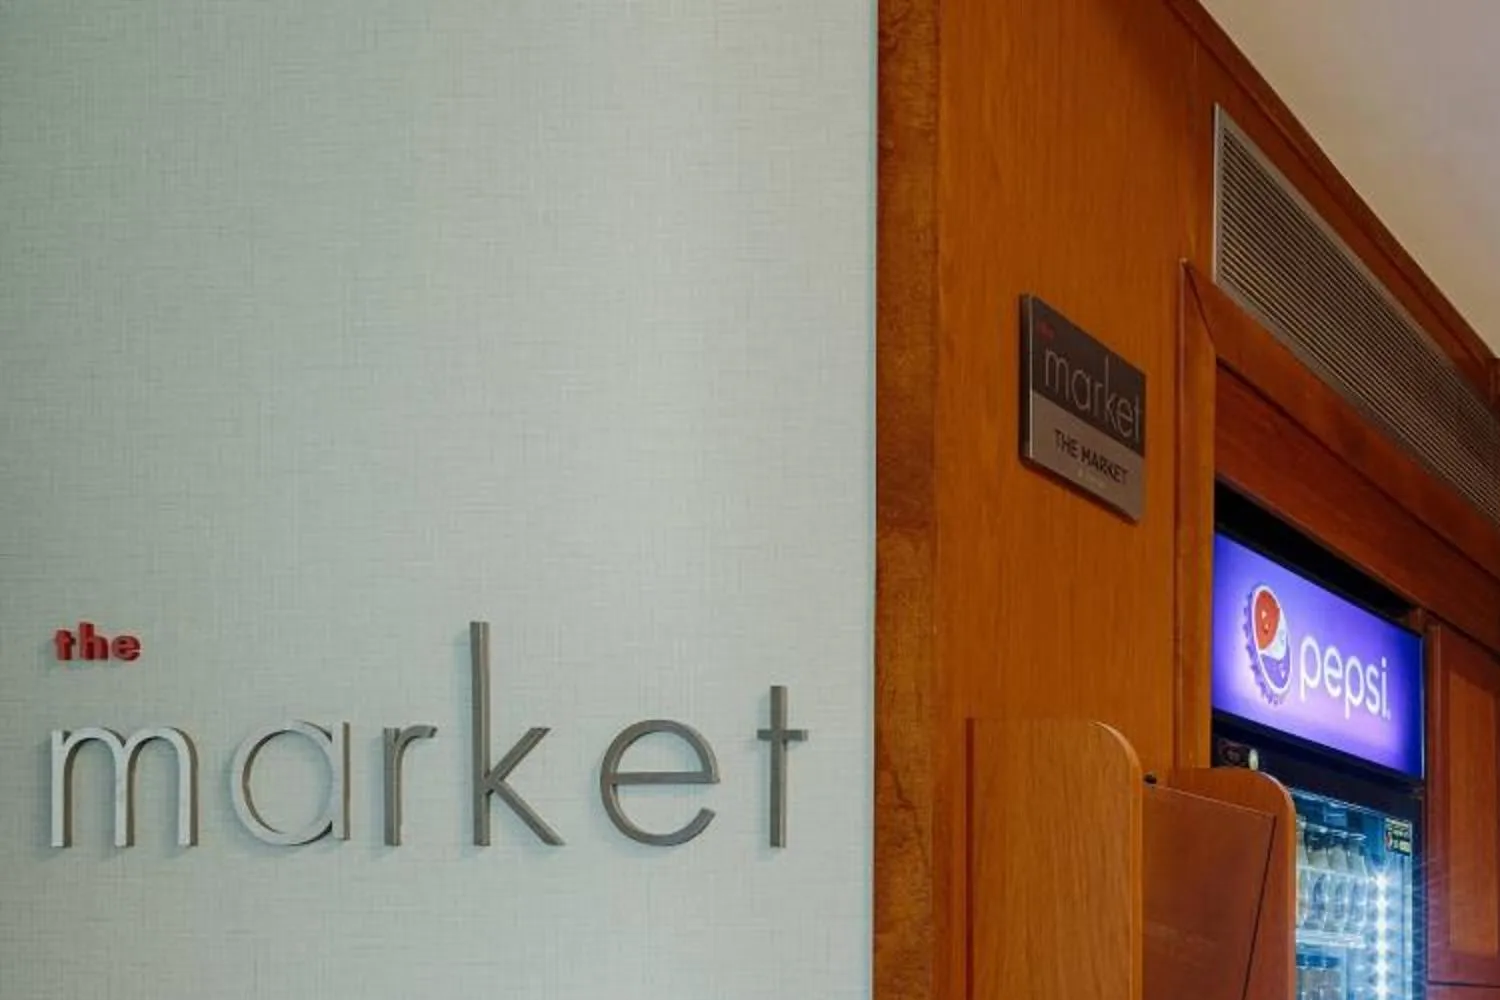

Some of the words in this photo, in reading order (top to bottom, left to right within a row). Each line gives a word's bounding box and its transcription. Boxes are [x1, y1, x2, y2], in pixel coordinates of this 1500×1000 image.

[1044, 348, 1141, 443] market
[1054, 428, 1079, 459] THE
[1081, 446, 1128, 485] MARKET
[54, 622, 142, 662] the
[1300, 634, 1388, 719] pepsi
[51, 621, 808, 848] market
